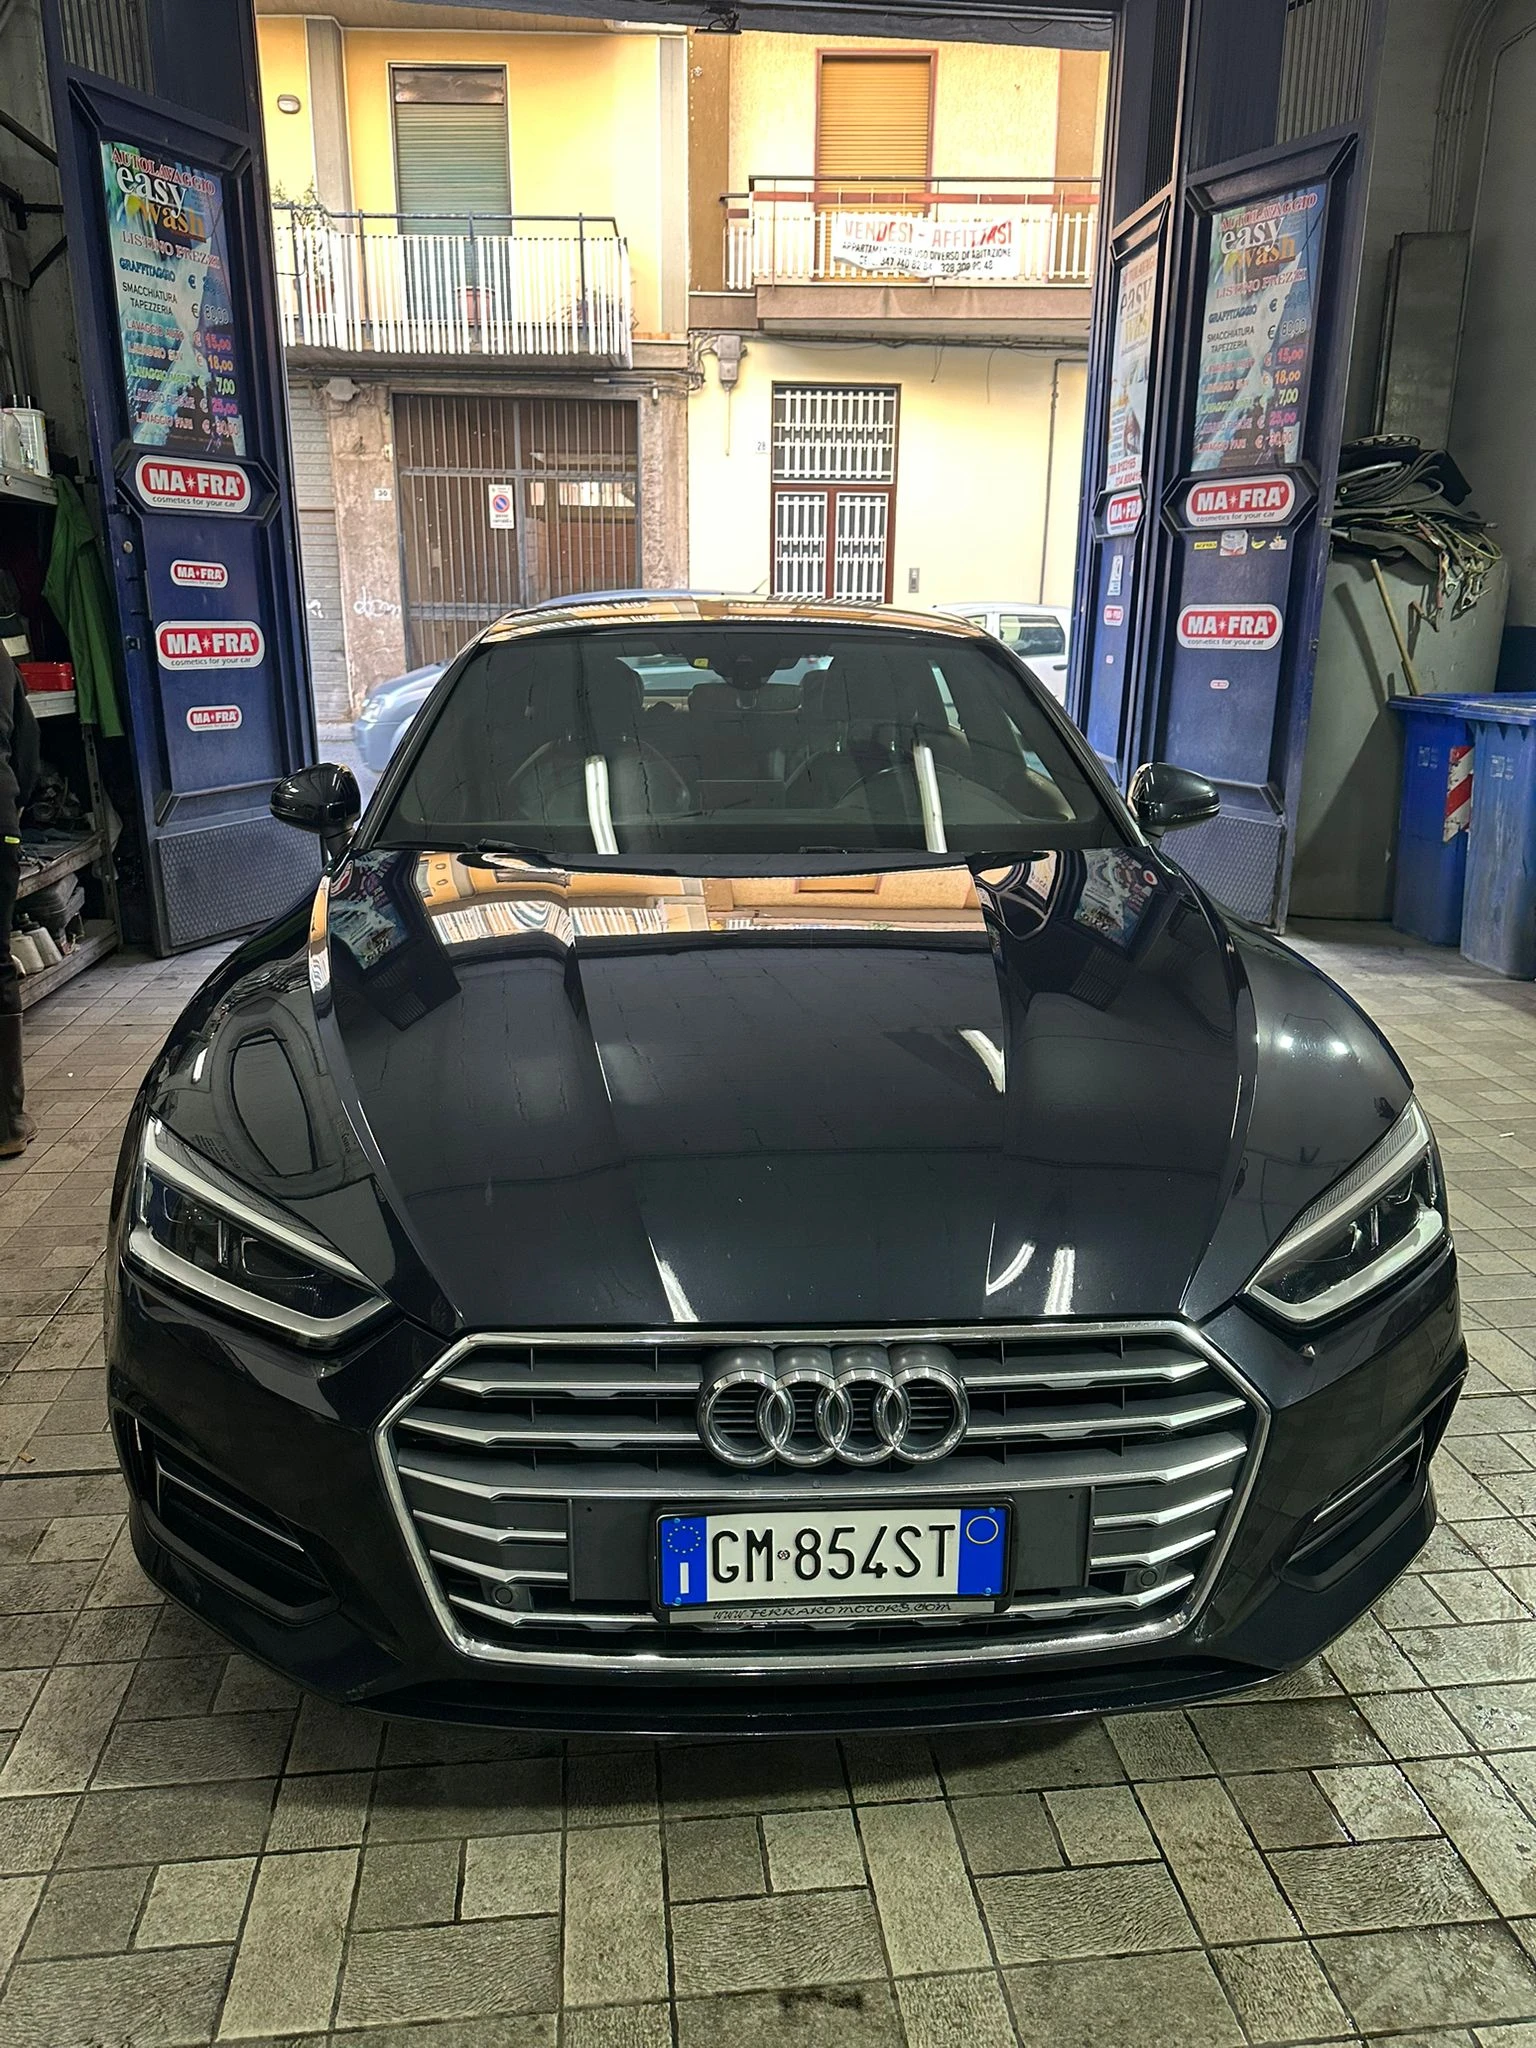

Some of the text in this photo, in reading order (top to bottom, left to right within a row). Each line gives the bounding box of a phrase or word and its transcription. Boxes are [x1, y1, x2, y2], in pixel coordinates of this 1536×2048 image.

[111, 147, 216, 196] AUTOLAVAGGIO
[116, 166, 188, 219] easy
[139, 199, 206, 240] wash
[1221, 193, 1318, 231] AUTOLAVAGGIO
[121, 230, 175, 256] LISTINO
[844, 219, 913, 244] VENDESI
[931, 219, 1012, 248] AFFITTASI
[1221, 216, 1285, 254] easy
[929, 249, 960, 261] DIVERSO
[1237, 238, 1296, 268] wash
[122, 281, 178, 304] SMACCHIATURA
[129, 297, 173, 317] TAPEZZERIA
[1207, 325, 1255, 344] SMACCHIATURA
[1210, 340, 1248, 354] TAPEZZERIA
[207, 353, 234, 373] 18,00
[1275, 369, 1301, 386] 18,00
[149, 468, 240, 497] MA FRA
[152, 496, 191, 505] cosmetics
[192, 498, 204, 506] for
[206, 499, 223, 508] your
[1196, 486, 1282, 511] MA FRA
[1196, 515, 1230, 523] cosmetics
[1231, 512, 1243, 520] for
[1244, 512, 1262, 520] your
[177, 566, 222, 580] MA FRA
[1187, 616, 1270, 635] MA FRA
[166, 632, 255, 655] MA FRA
[171, 657, 208, 666] cosmetics
[209, 657, 220, 665] for
[192, 711, 238, 724] MA FRA
[711, 1527, 774, 1584] GM
[794, 1524, 956, 1581] 854ST
